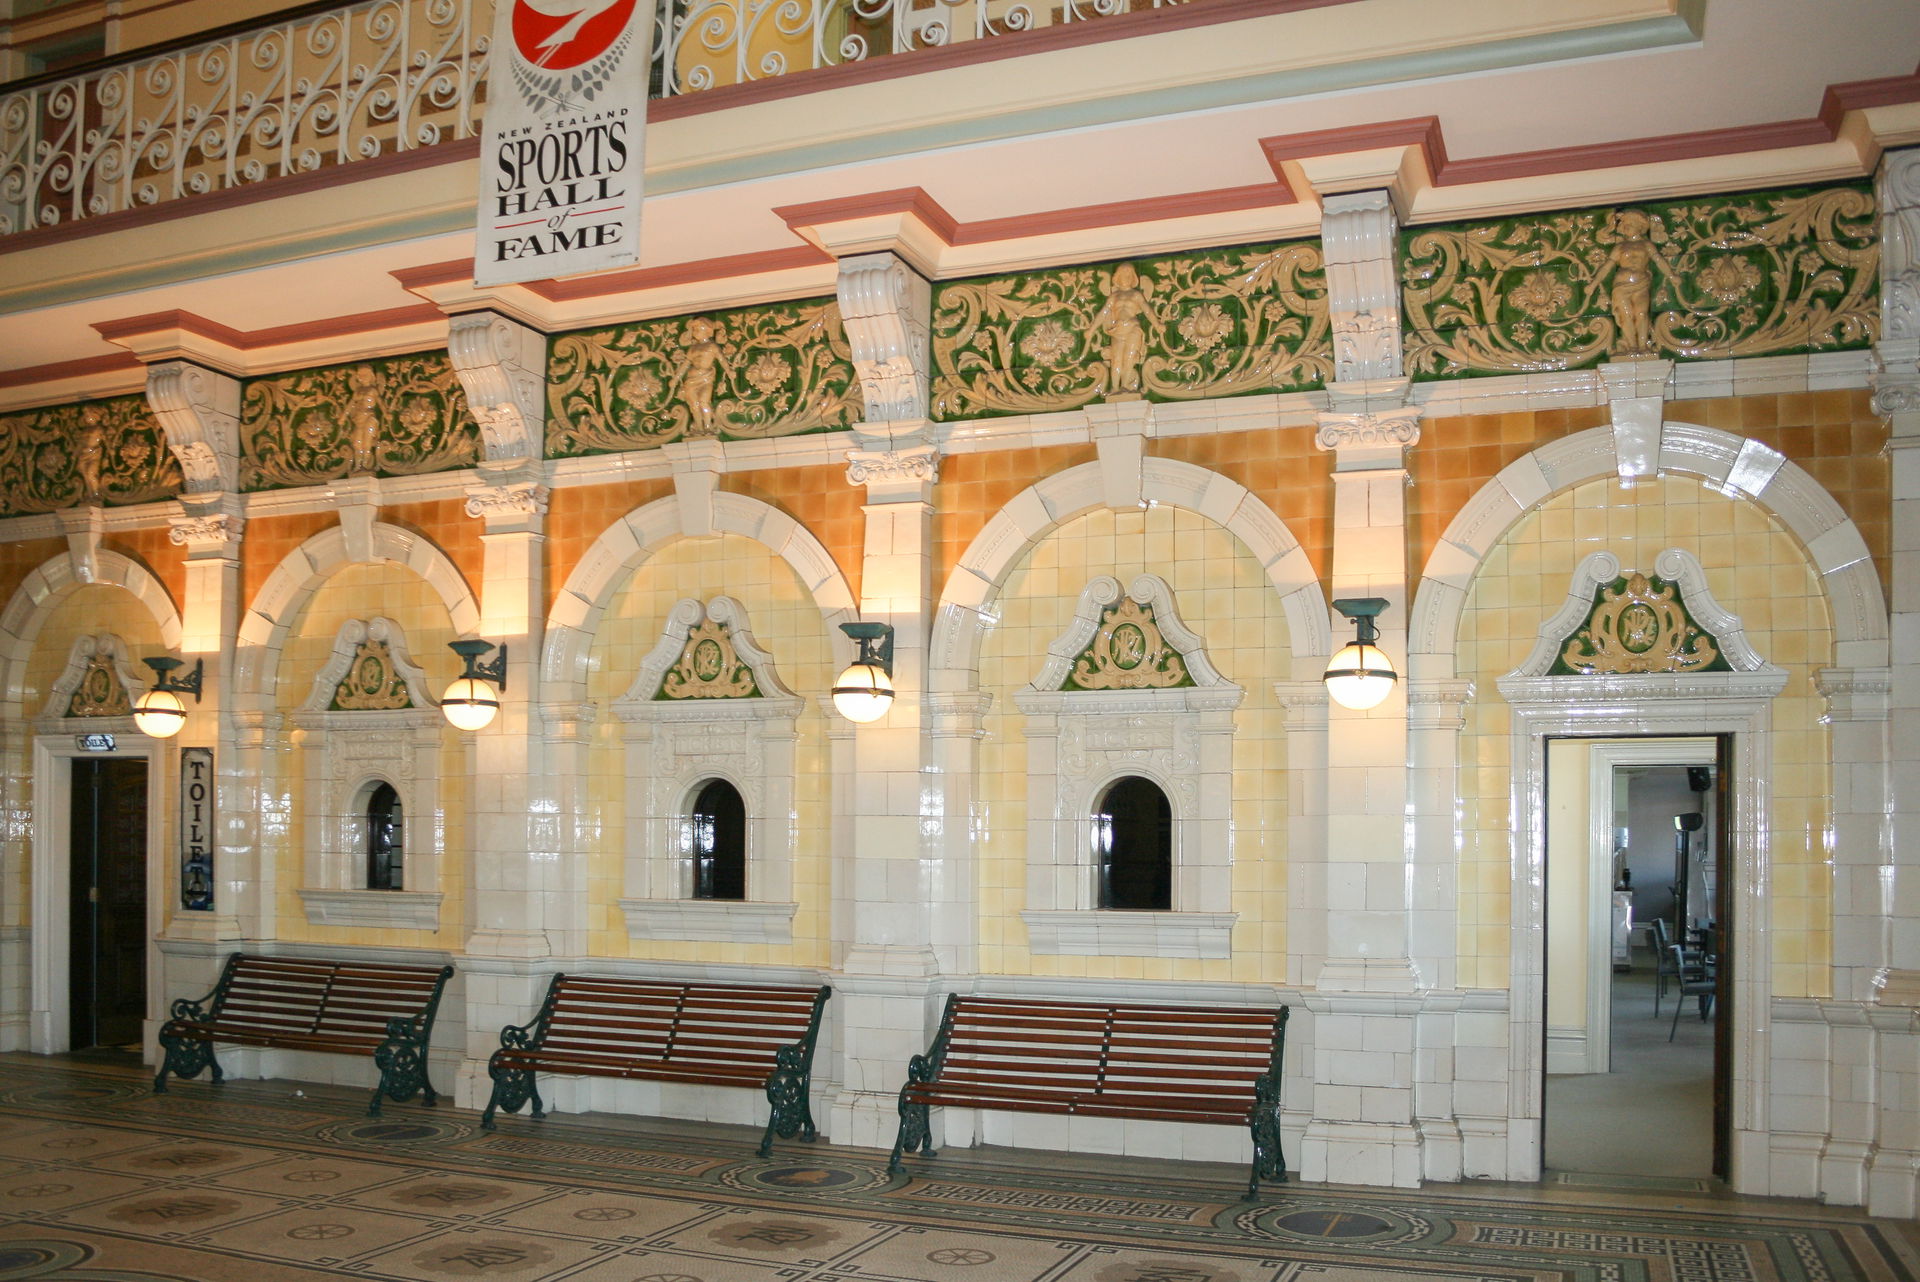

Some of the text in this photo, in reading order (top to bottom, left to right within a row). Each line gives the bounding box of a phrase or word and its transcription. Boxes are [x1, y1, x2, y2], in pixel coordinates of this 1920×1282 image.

[498, 108, 629, 140] NEW ZEALAND
[497, 120, 628, 193] SPORTS
[494, 176, 626, 218] HALL
[547, 207, 576, 231] of
[493, 221, 623, 262] FAME
[190, 761, 205, 884] TOILET
